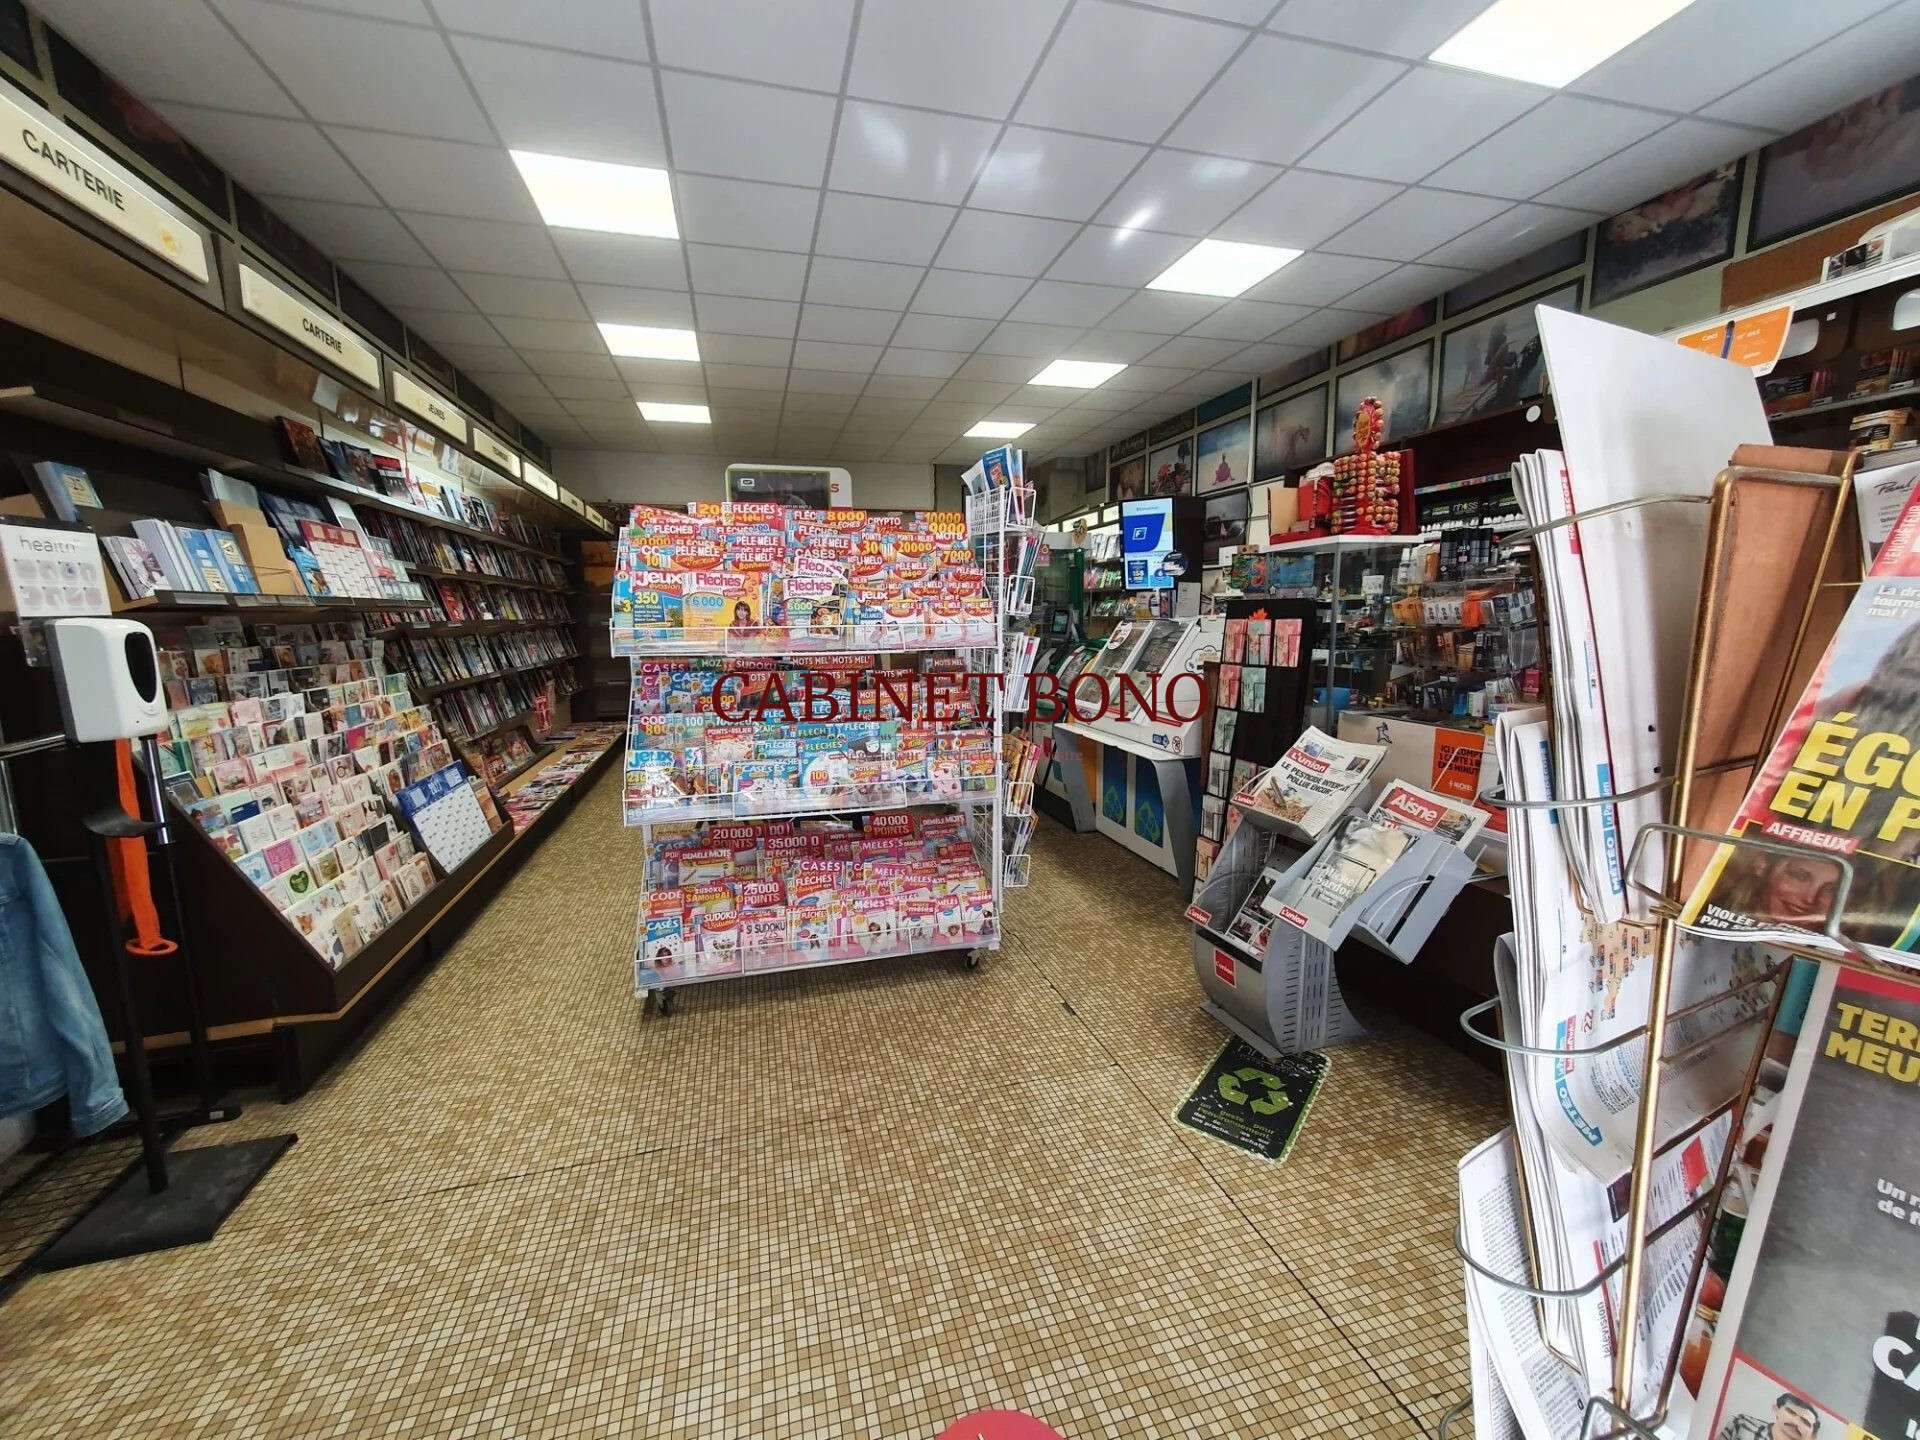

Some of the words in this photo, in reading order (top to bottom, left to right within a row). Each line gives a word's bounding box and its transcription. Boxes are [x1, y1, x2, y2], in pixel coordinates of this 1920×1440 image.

[22, 128, 127, 211] CARTERIE
[302, 317, 343, 354] CARTERIE
[635, 592, 659, 604] 350
[1281, 761, 1290, 770] LE
[1792, 711, 1920, 796] ÉG
[1390, 793, 1438, 822] Aisne
[1769, 770, 1871, 830] EN
[1766, 822, 1853, 851] AFFREUX
[1836, 1001, 1920, 1053] TER
[1877, 1178, 1907, 1203] Un
[1877, 1199, 1907, 1221] de
